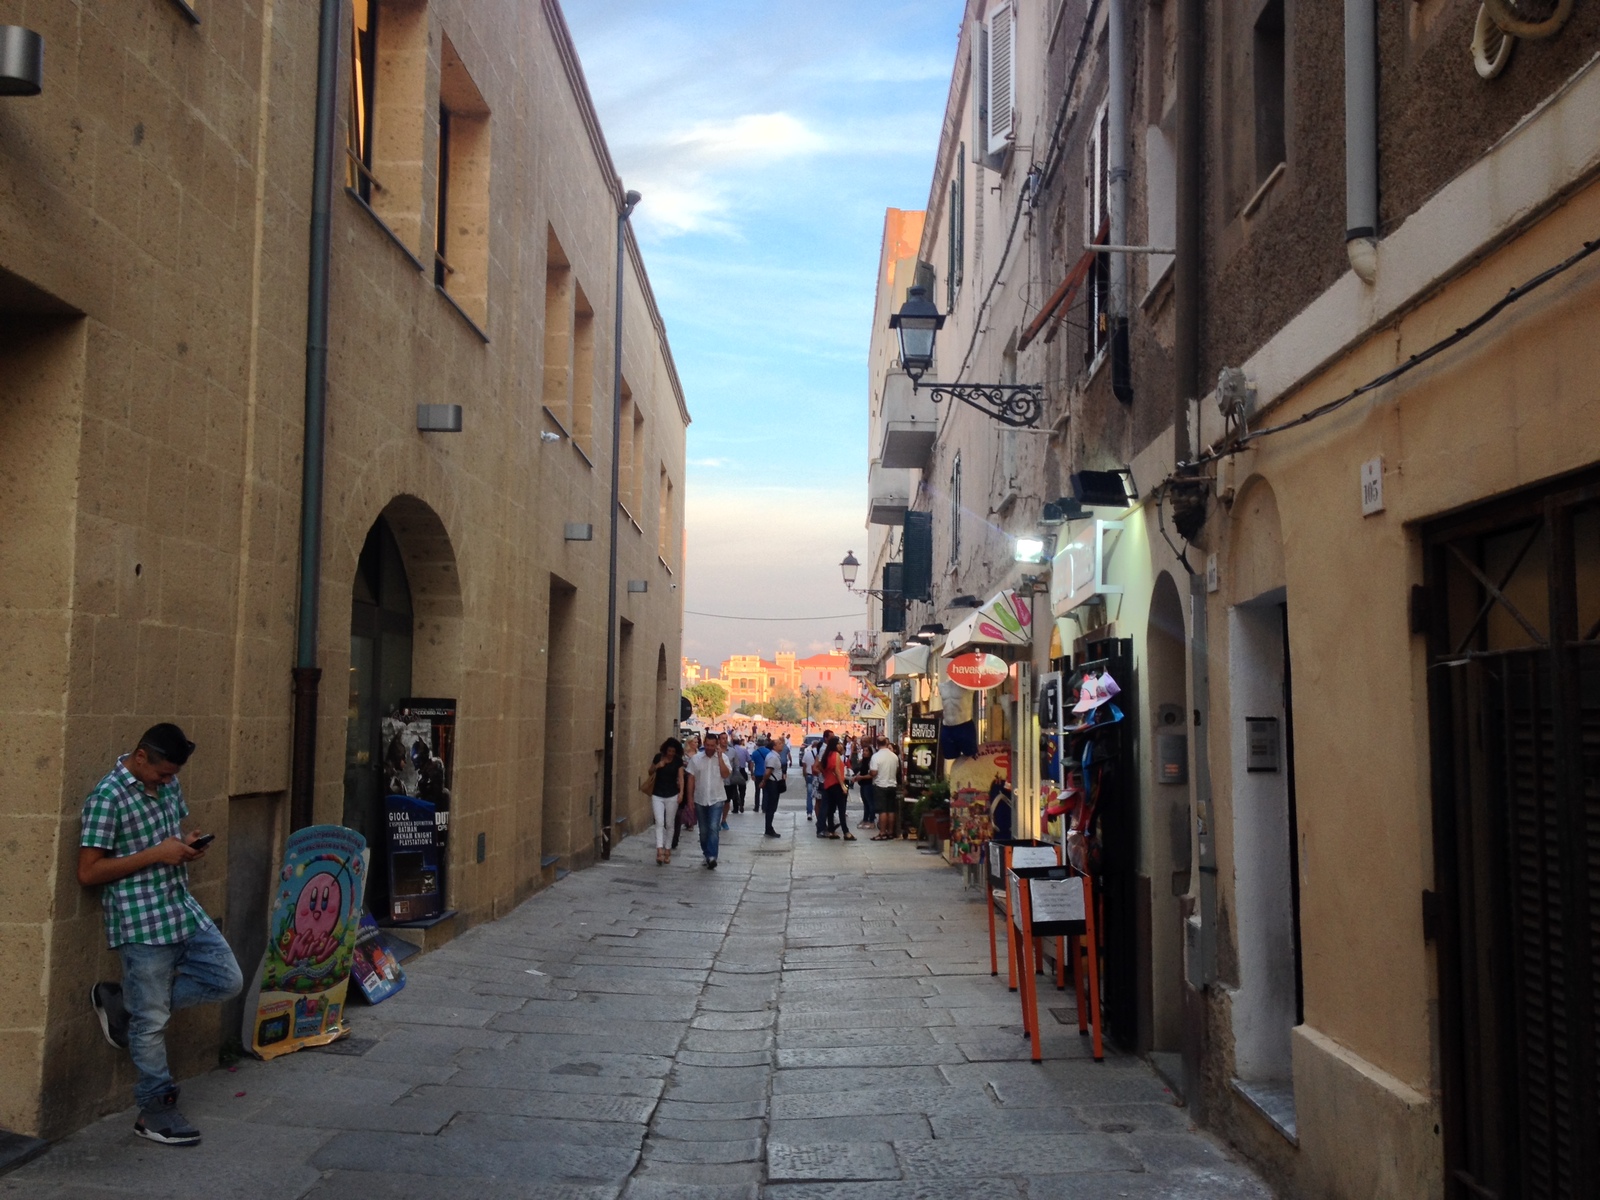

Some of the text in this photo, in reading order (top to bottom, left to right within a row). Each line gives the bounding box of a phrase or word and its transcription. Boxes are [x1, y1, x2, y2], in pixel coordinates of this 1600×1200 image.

[911, 729, 936, 738] BRIVIDO
[389, 812, 409, 821] GIOCA
[393, 832, 413, 840] ARKHAM
[285, 928, 339, 967] Kirby
